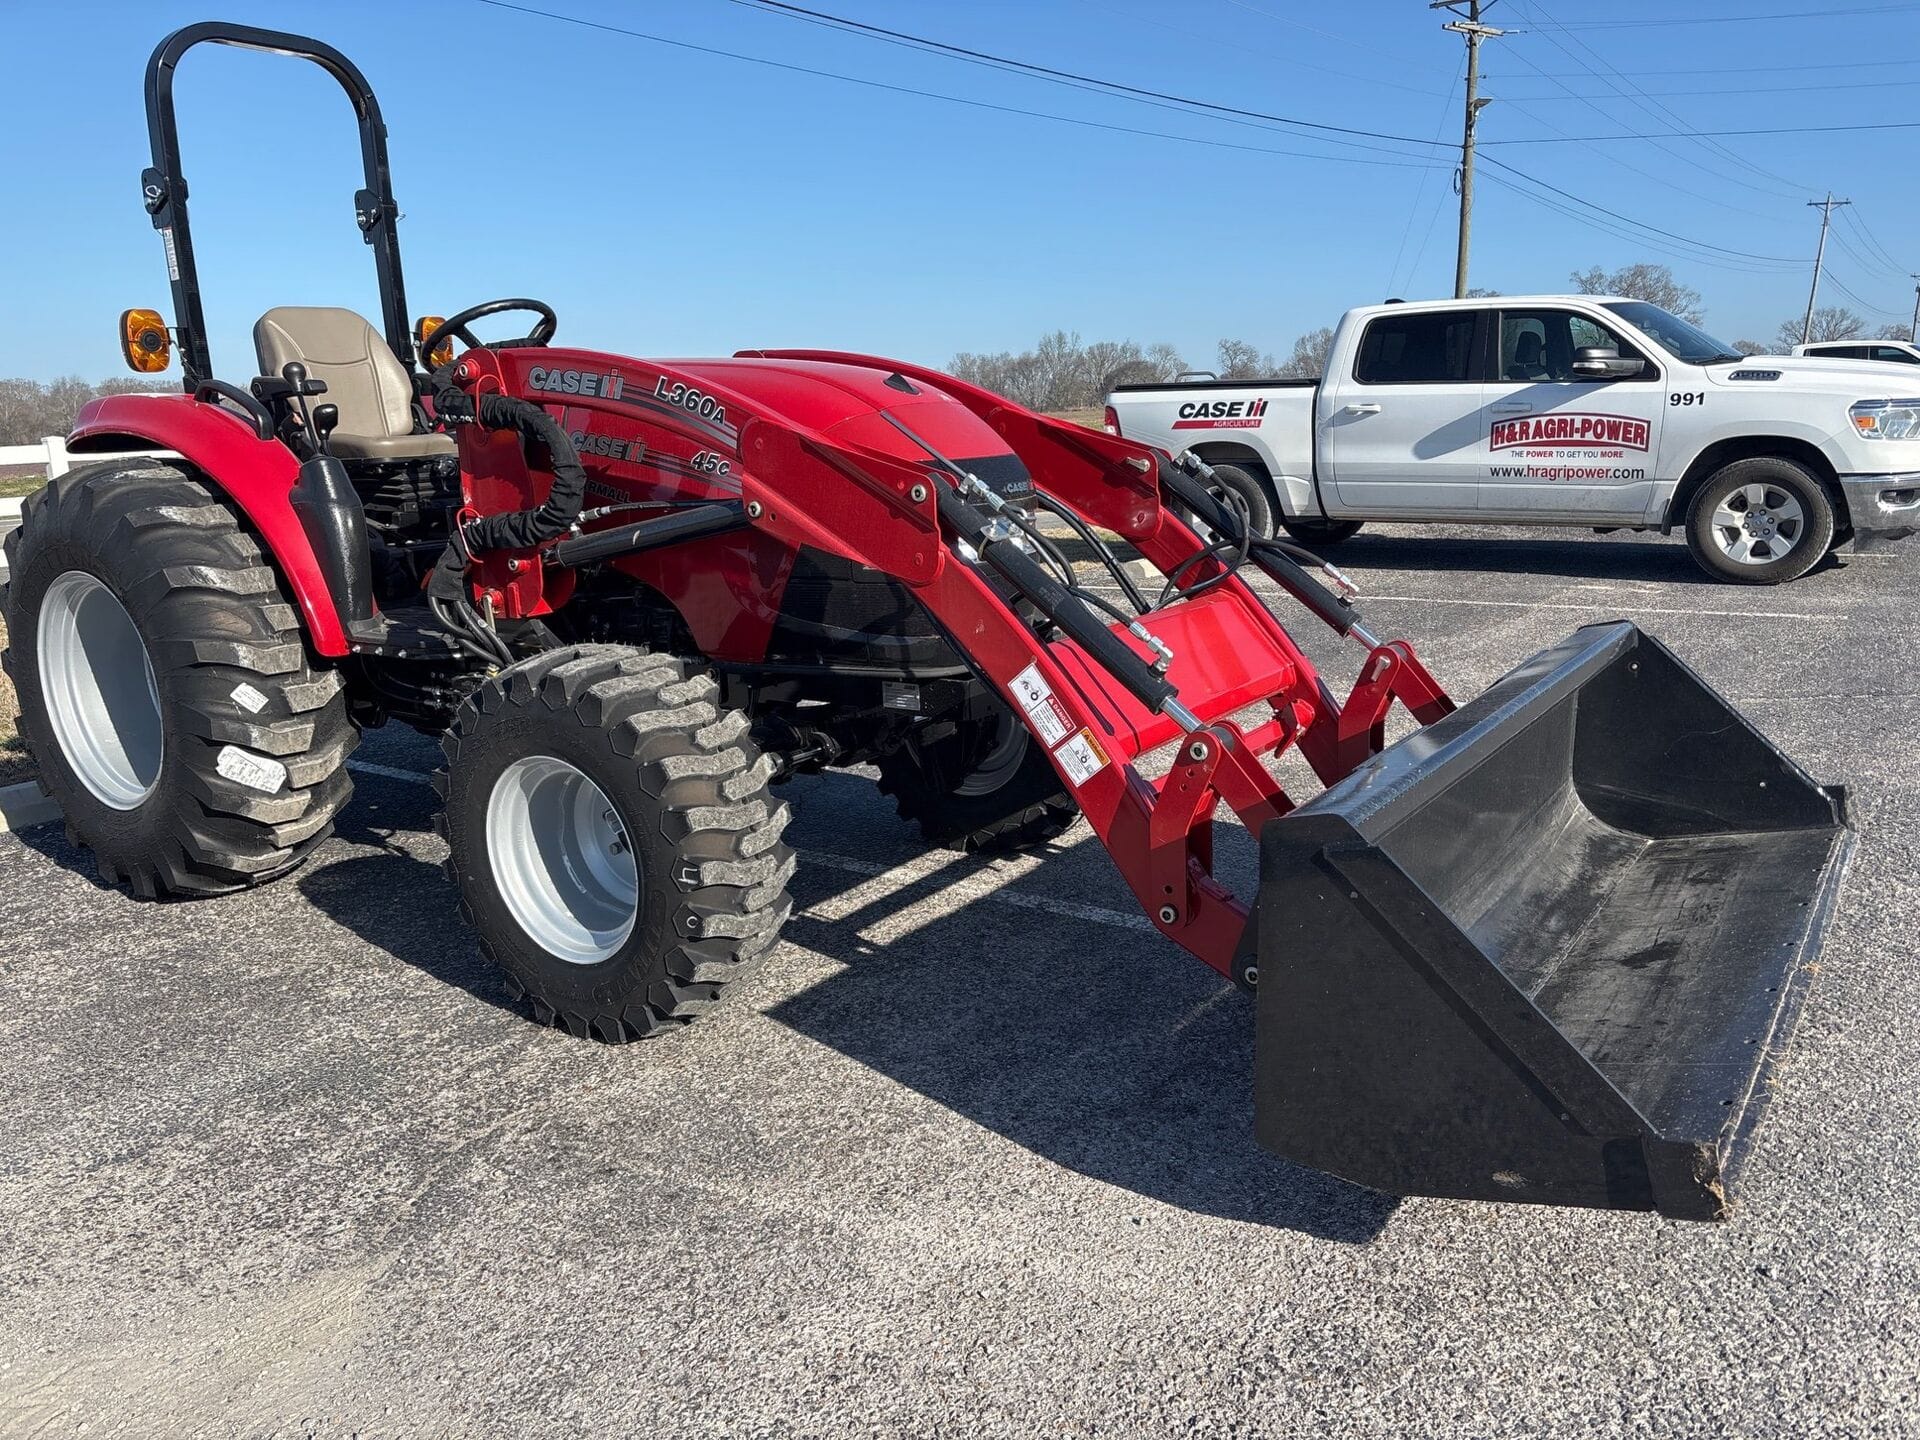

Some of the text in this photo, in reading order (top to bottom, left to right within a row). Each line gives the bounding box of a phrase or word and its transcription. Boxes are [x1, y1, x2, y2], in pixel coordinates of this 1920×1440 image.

[528, 366, 598, 396] CASE
[652, 375, 727, 426] L360A
[1178, 401, 1245, 419] CASE
[1669, 391, 1705, 406] 991
[1212, 420, 1260, 428] AGRICULTURE
[1494, 418, 1646, 446] H&R AGRI-POWER
[570, 430, 626, 459] CASE
[1511, 450, 1624, 458] THE POWER TO GET YOU MORE
[1490, 465, 1645, 481] www.hragripower.com
[1053, 703, 1073, 731] DANGER
